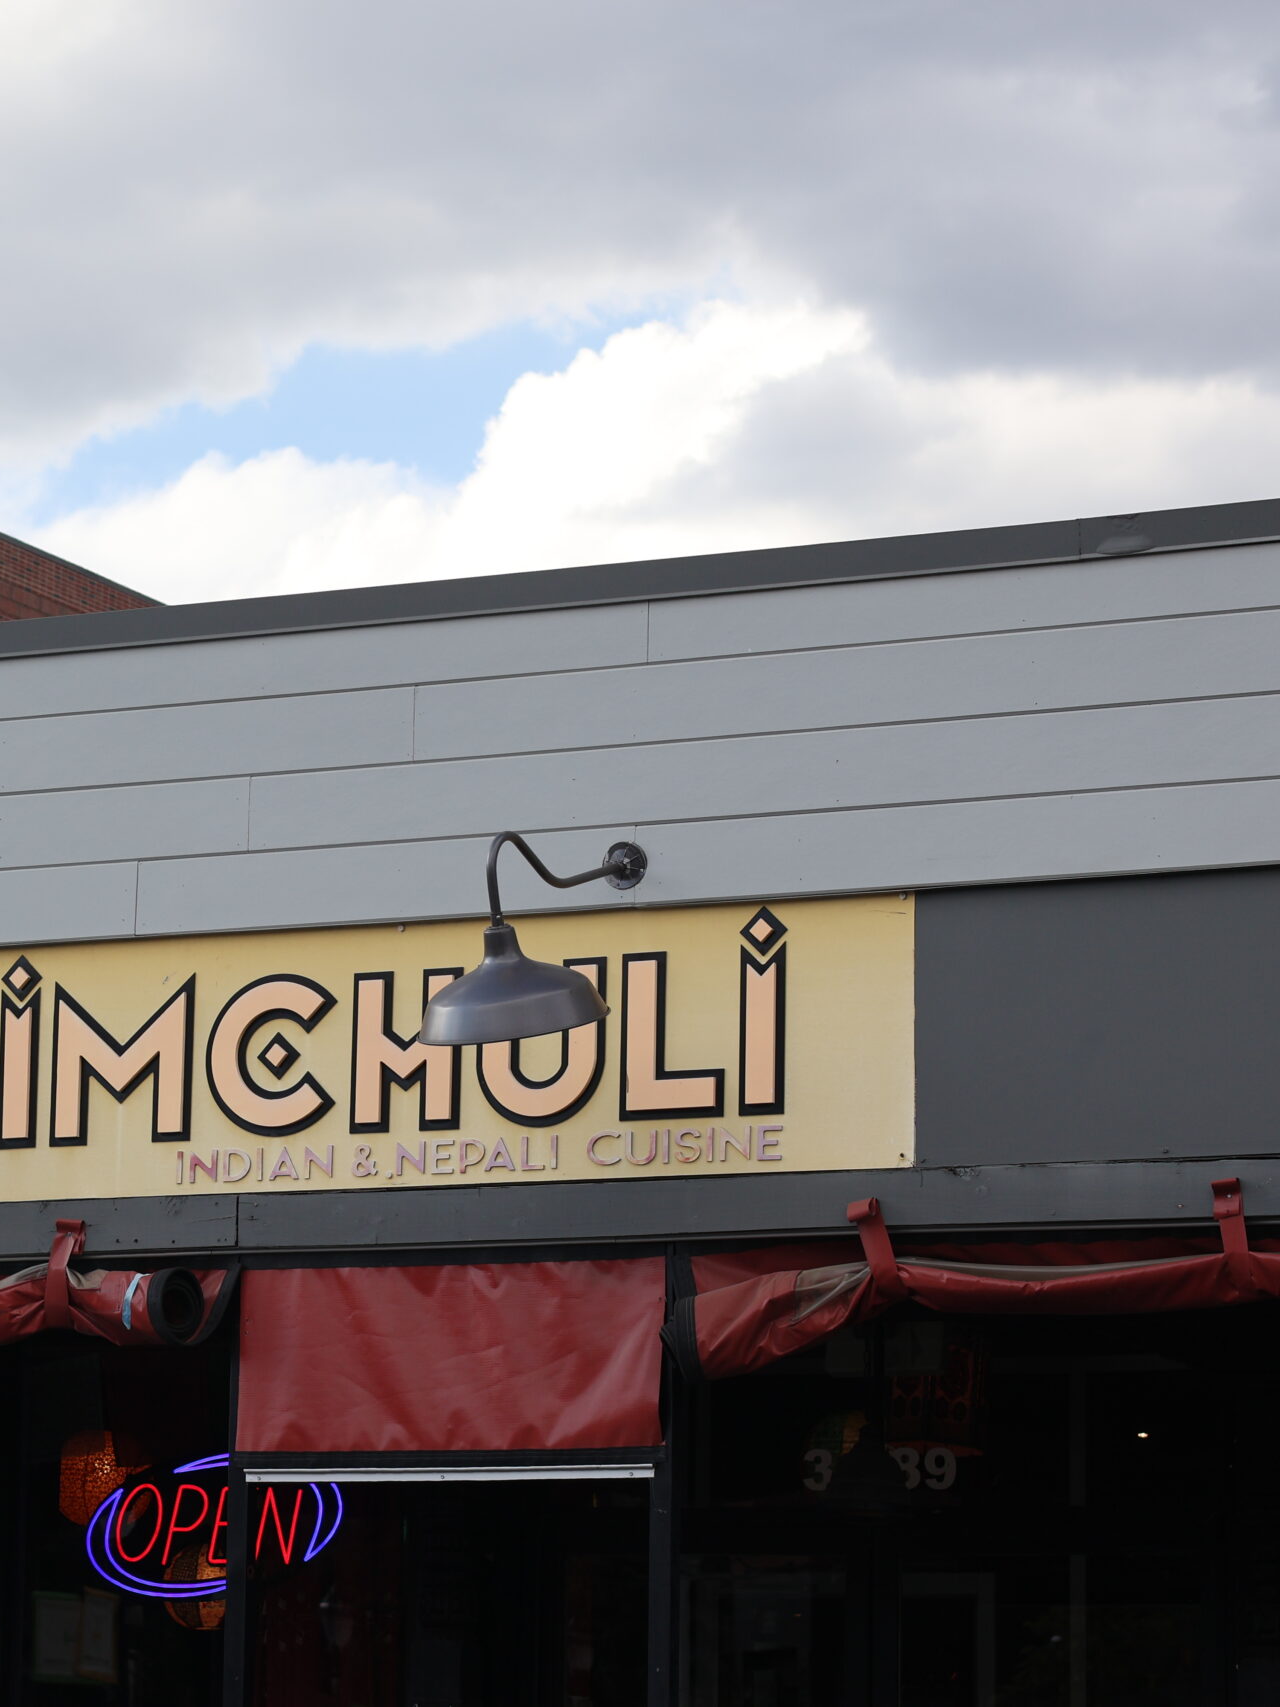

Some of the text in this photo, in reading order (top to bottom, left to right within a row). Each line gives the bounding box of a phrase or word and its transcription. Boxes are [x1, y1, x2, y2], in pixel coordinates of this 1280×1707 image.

[175, 1124, 784, 1186] INDIAN & NEPALI CUISINE
[801, 1446, 958, 1491] 389
